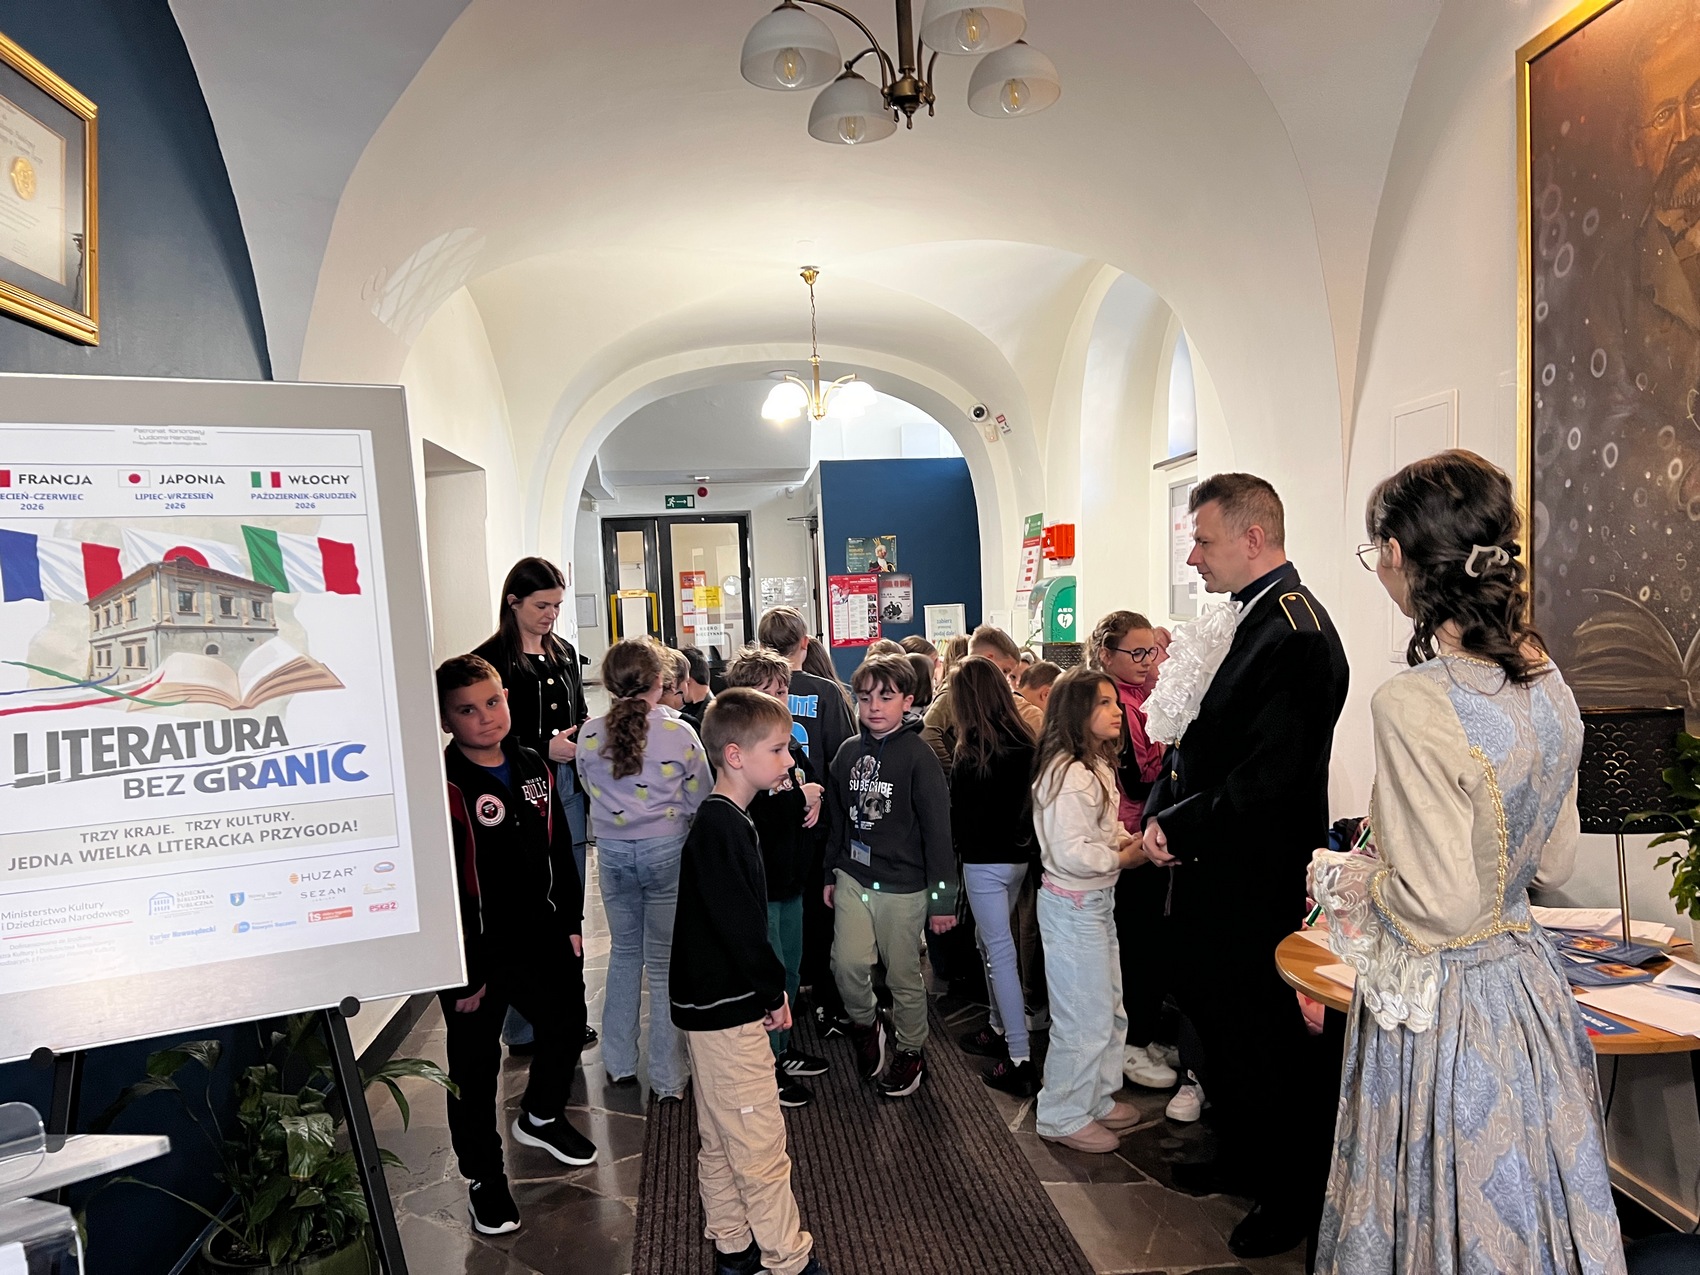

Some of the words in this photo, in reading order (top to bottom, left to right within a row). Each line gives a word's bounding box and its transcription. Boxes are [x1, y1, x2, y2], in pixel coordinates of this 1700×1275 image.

[18, 473, 93, 485] FRANCJA
[159, 474, 226, 485] JAPONIA
[288, 474, 350, 485] WŁOCHY
[135, 491, 214, 500] LIPIEC-WRZESIEŃ
[165, 502, 186, 510] 2026
[13, 715, 290, 788] LITERATURA
[123, 774, 186, 800] BEZ
[193, 743, 370, 793] GRANIC
[849, 779, 894, 798] SUBSCRIBE
[80, 830, 120, 844] TRZY
[123, 823, 175, 839] KRAJE.
[185, 819, 221, 832] TRZY
[226, 811, 295, 828] KULTURY.
[8, 852, 74, 872] JEDNA
[79, 844, 152, 862] WIELKA
[157, 832, 254, 855] LITERACKA
[260, 819, 359, 842] PRZYGODA!
[300, 887, 347, 899] SEZAM
[1, 907, 67, 920] Ministerstwo
[68, 901, 105, 912] Kultury
[7, 917, 67, 931] Dziedzictwa
[68, 908, 130, 923] Narodowego
